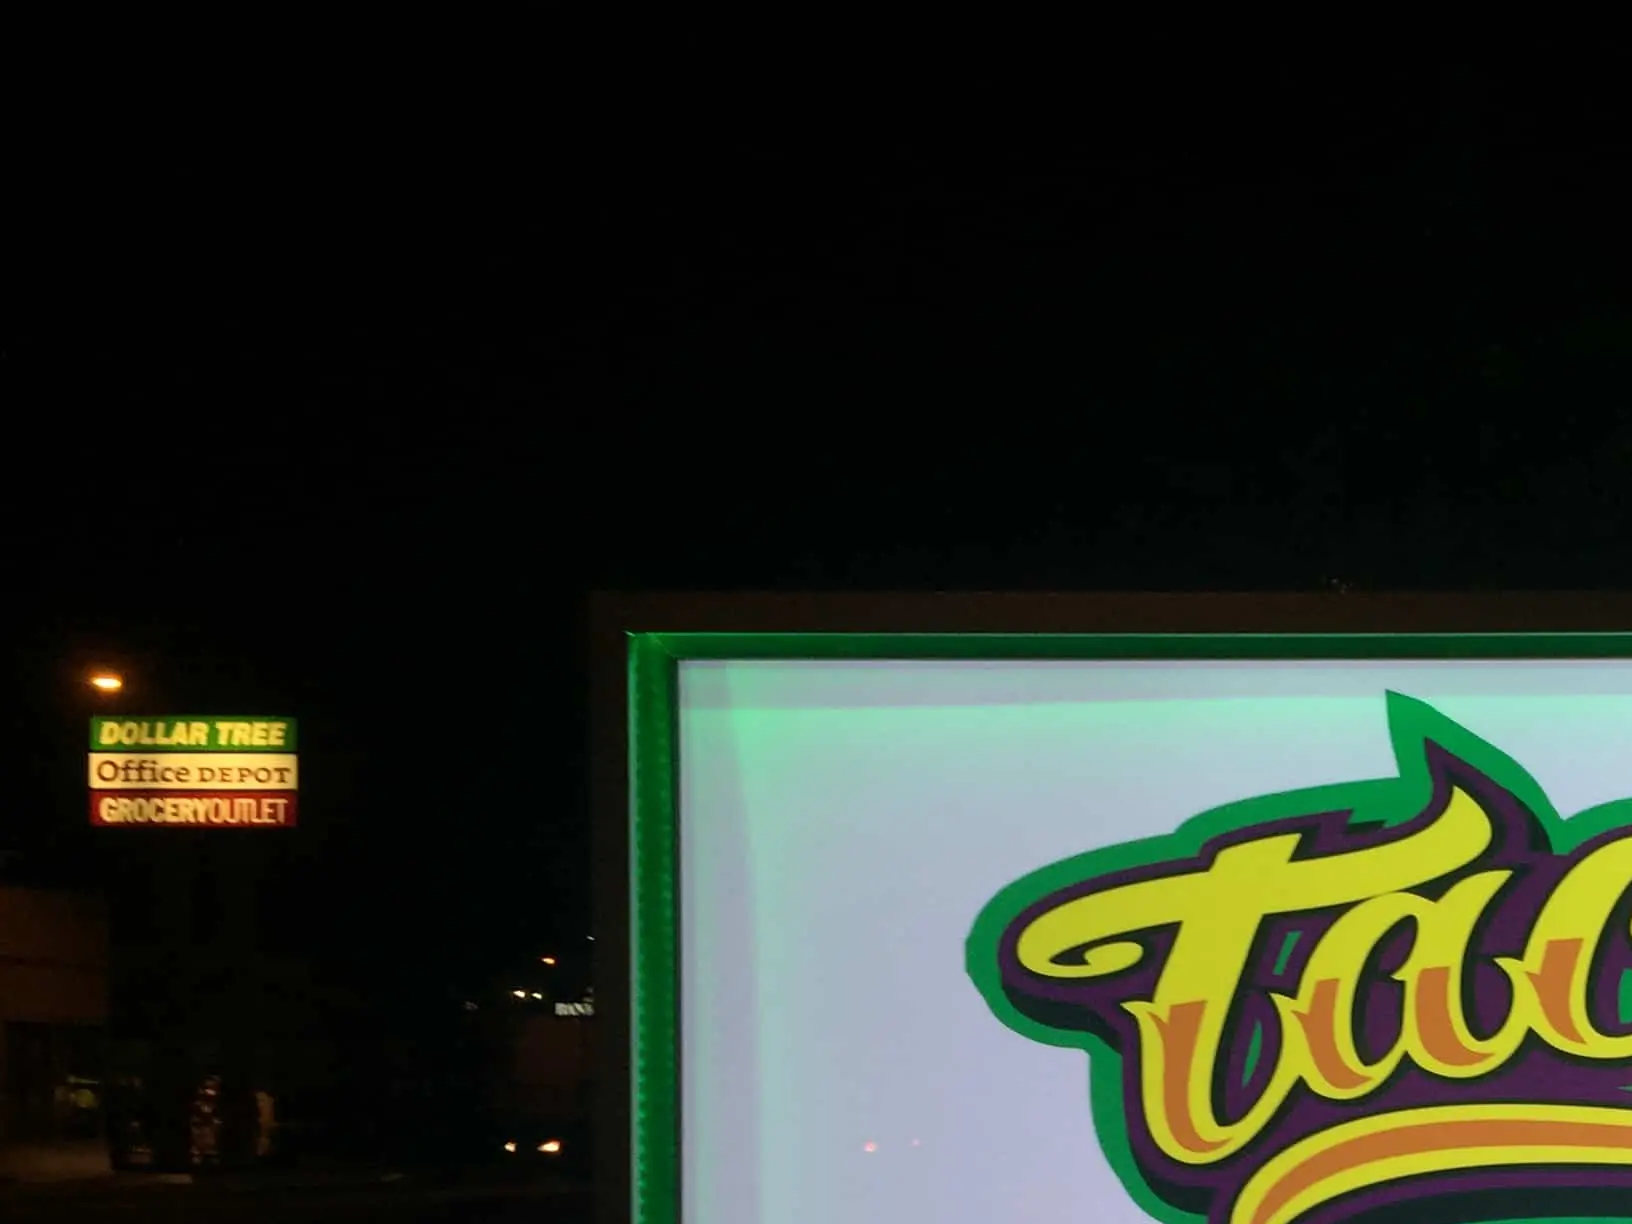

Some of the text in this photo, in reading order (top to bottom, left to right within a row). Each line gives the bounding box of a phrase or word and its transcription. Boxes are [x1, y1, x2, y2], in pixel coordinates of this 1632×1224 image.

[99, 720, 288, 746] DOLLAR TREE
[97, 759, 292, 784] Office DEPOT
